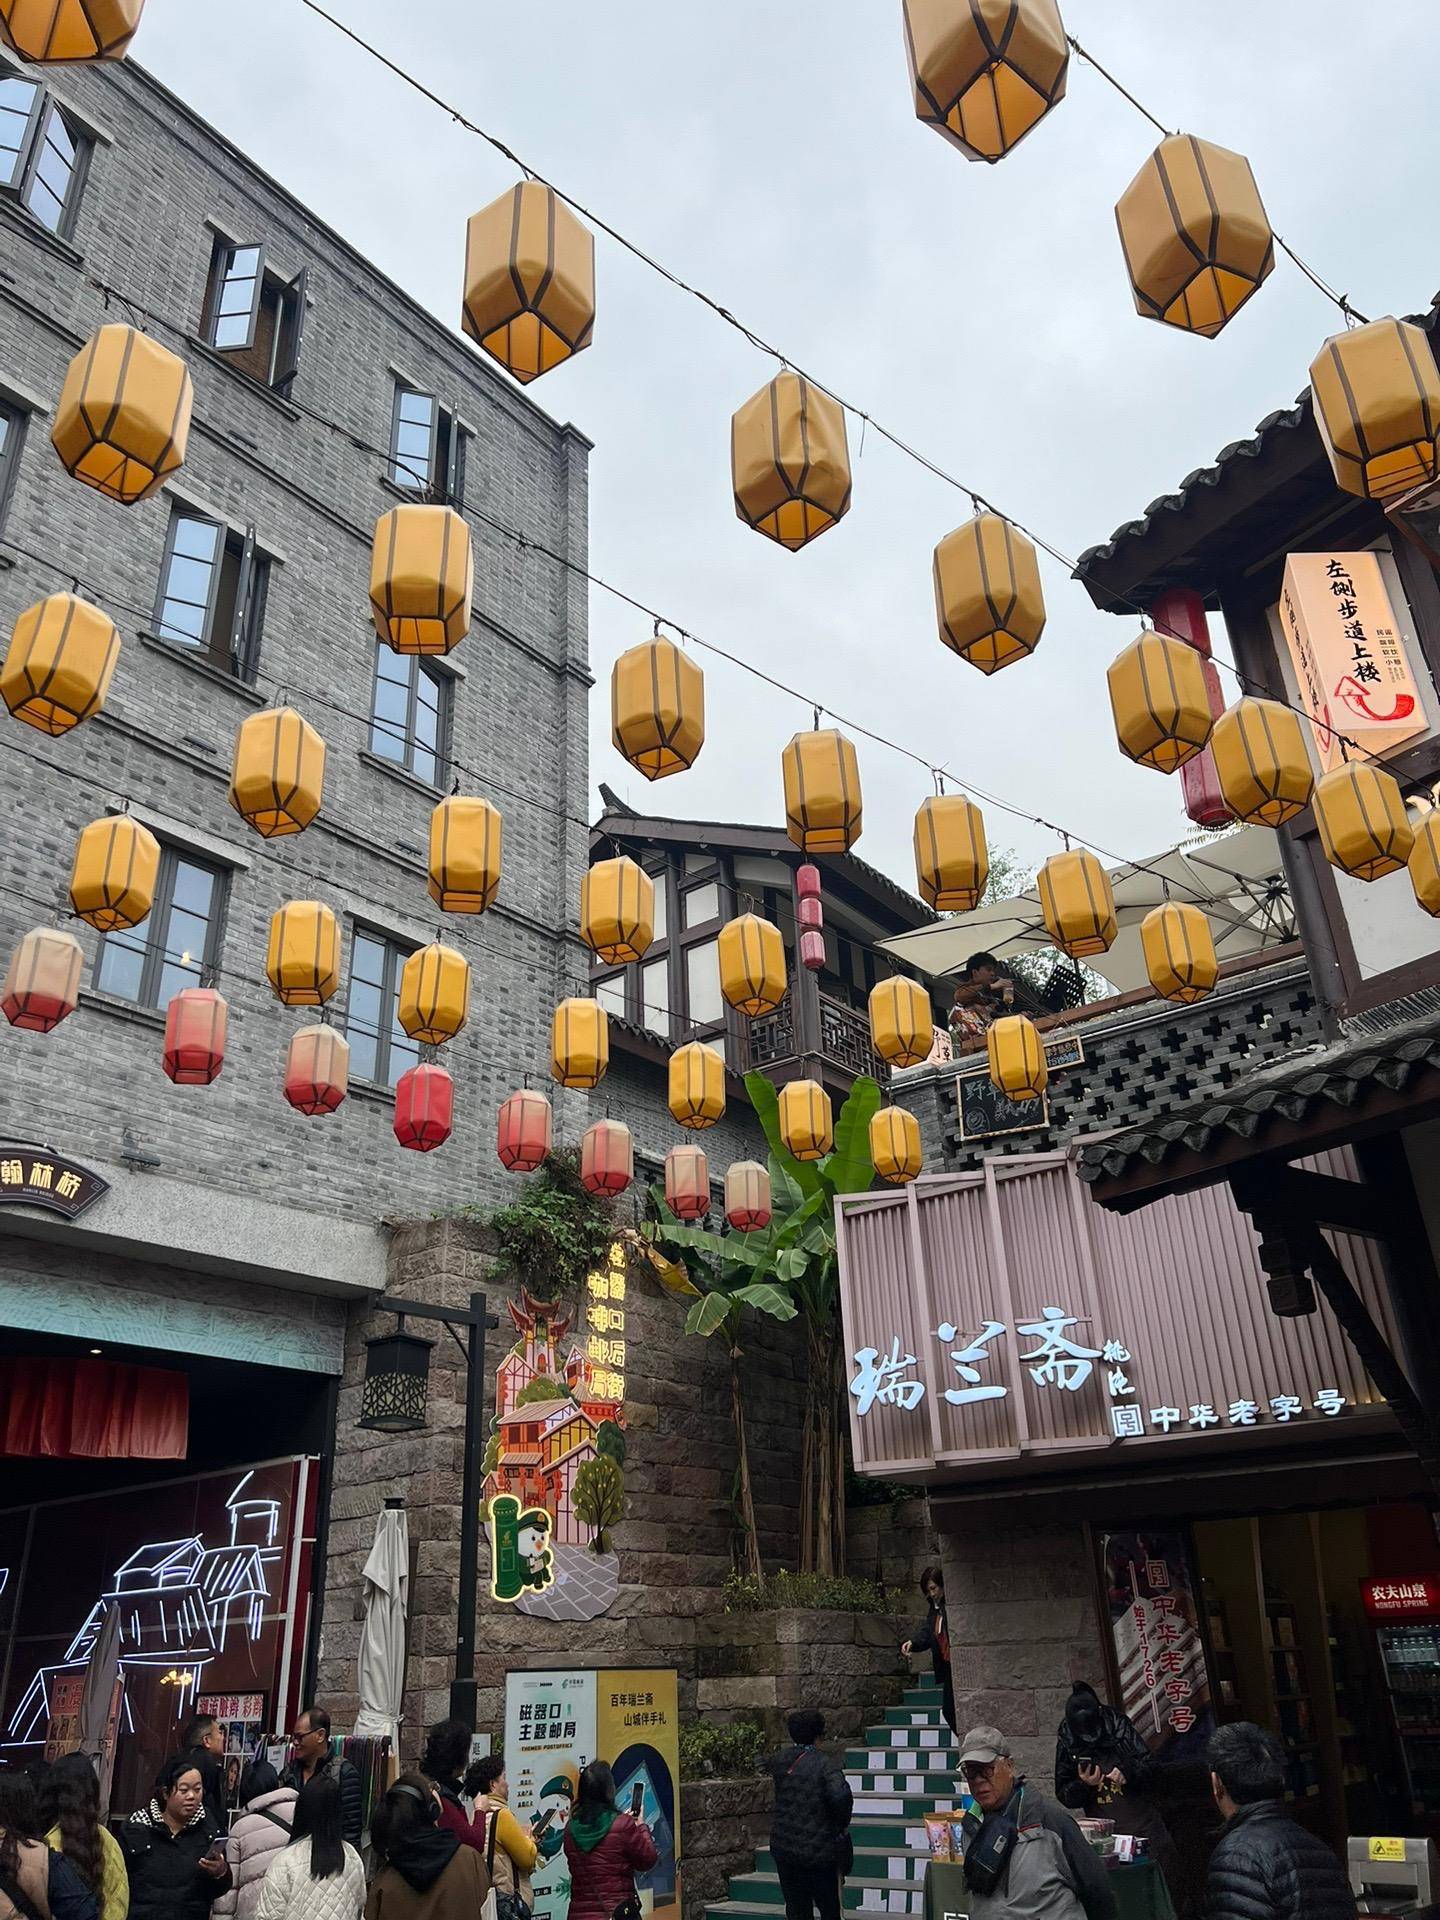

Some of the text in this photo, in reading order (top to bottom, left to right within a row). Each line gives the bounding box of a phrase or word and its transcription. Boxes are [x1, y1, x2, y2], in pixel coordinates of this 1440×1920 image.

[1326, 559, 1381, 682] 左侧步道上楼
[1, 1160, 82, 1199] 翰林桥
[588, 1272, 609, 1399] 咖啡邮局
[850, 1307, 1104, 1417] 瑞兰斋
[1150, 1389, 1346, 1432] 中华老字号
[1372, 1583, 1427, 1600] 农夫山泉
[1375, 1599, 1429, 1609] NONGFU SPRING
[1133, 1605, 1156, 1688] 始于1726
[1152, 1595, 1197, 1733] 中华老字号
[519, 1704, 561, 1720] 磁器口
[611, 1692, 653, 1707] 百年瑞兰斋
[624, 1711, 667, 1726] 山城伴手礼
[519, 1721, 576, 1740] 主题邮局
